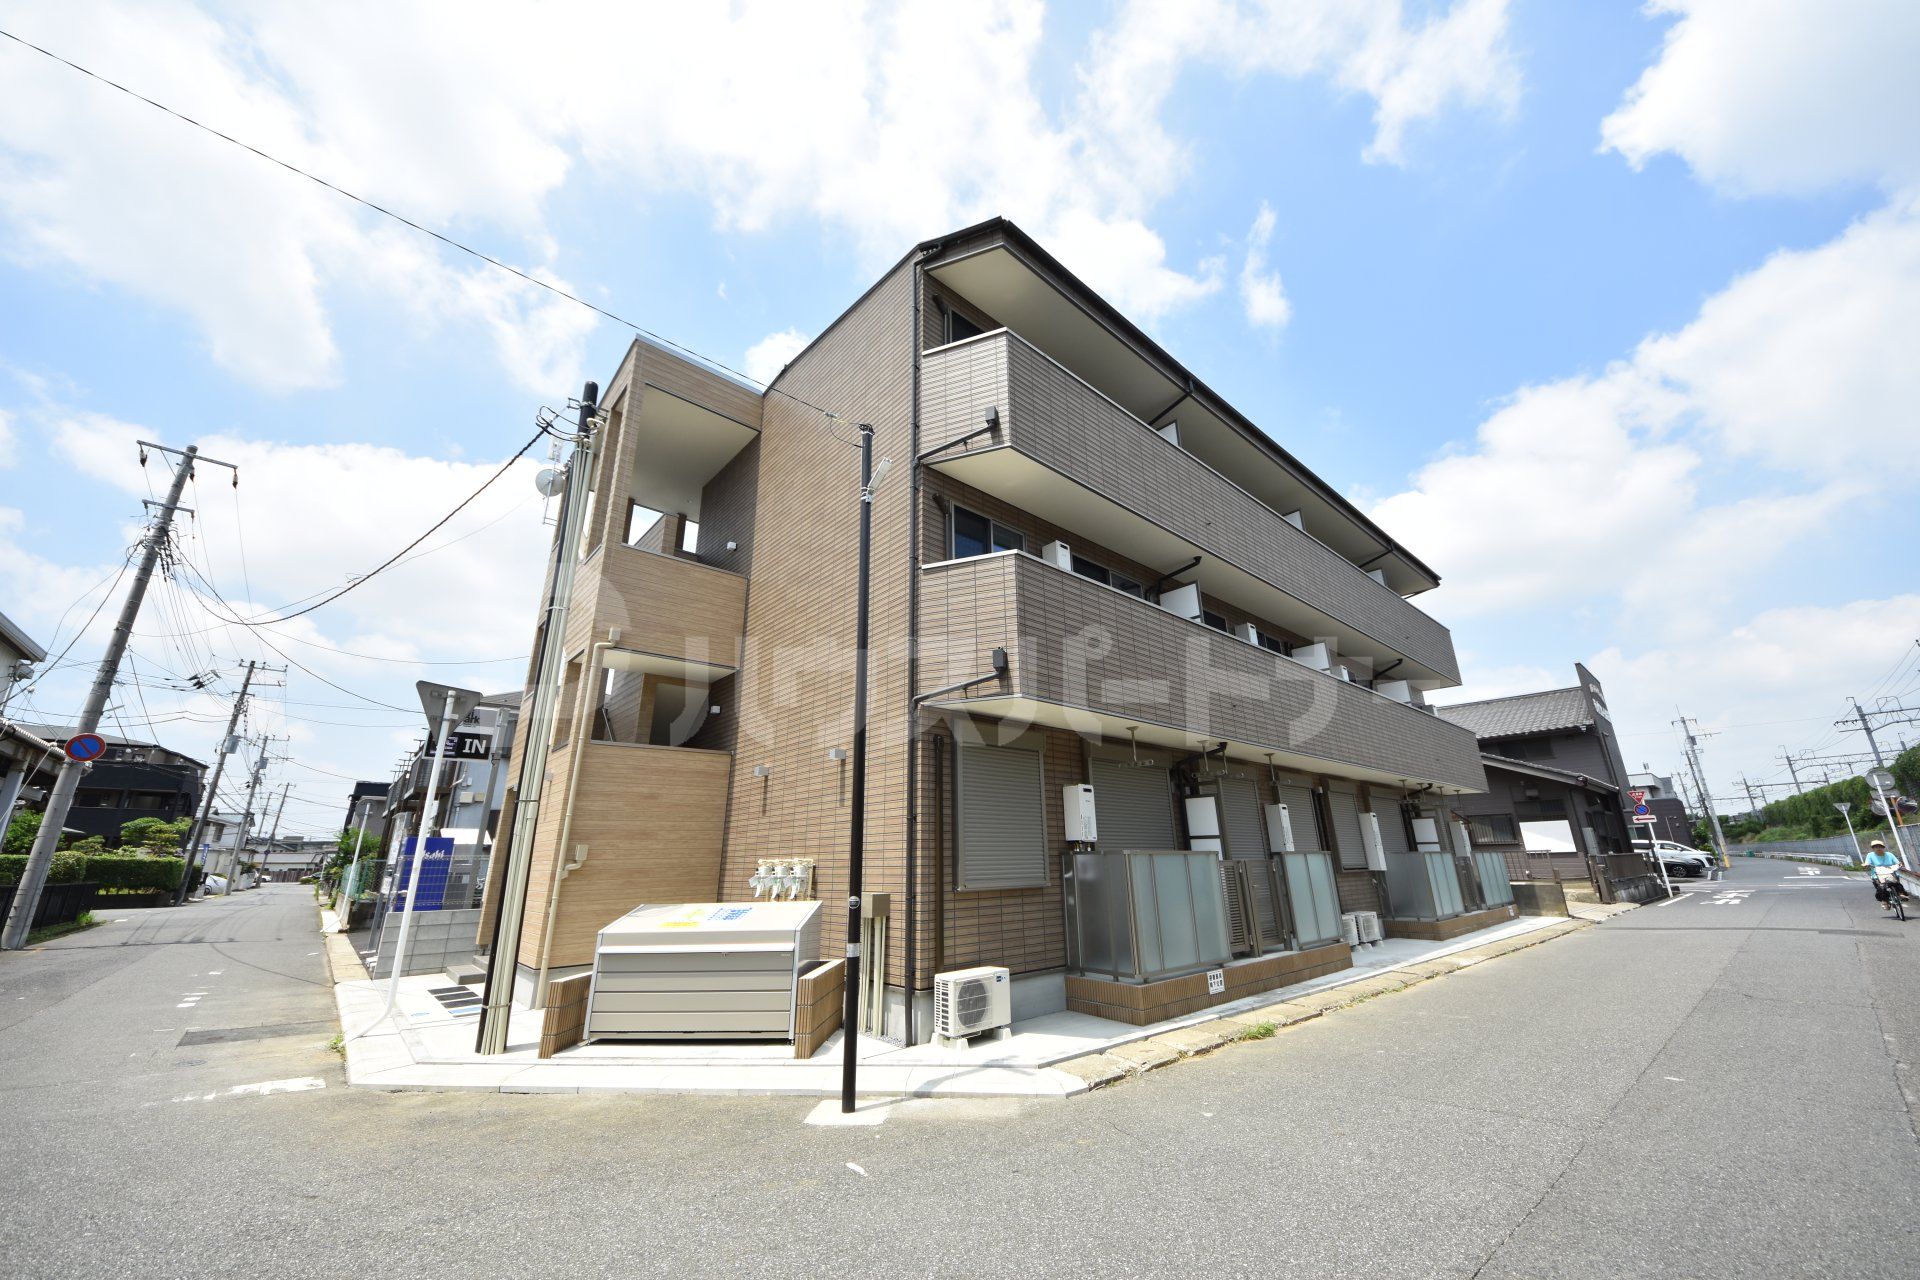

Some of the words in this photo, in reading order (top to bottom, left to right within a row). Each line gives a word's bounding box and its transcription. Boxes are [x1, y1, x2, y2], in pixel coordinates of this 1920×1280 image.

[463, 714, 481, 725] ark
[462, 738, 487, 754] IN
[422, 849, 446, 860] sahi
